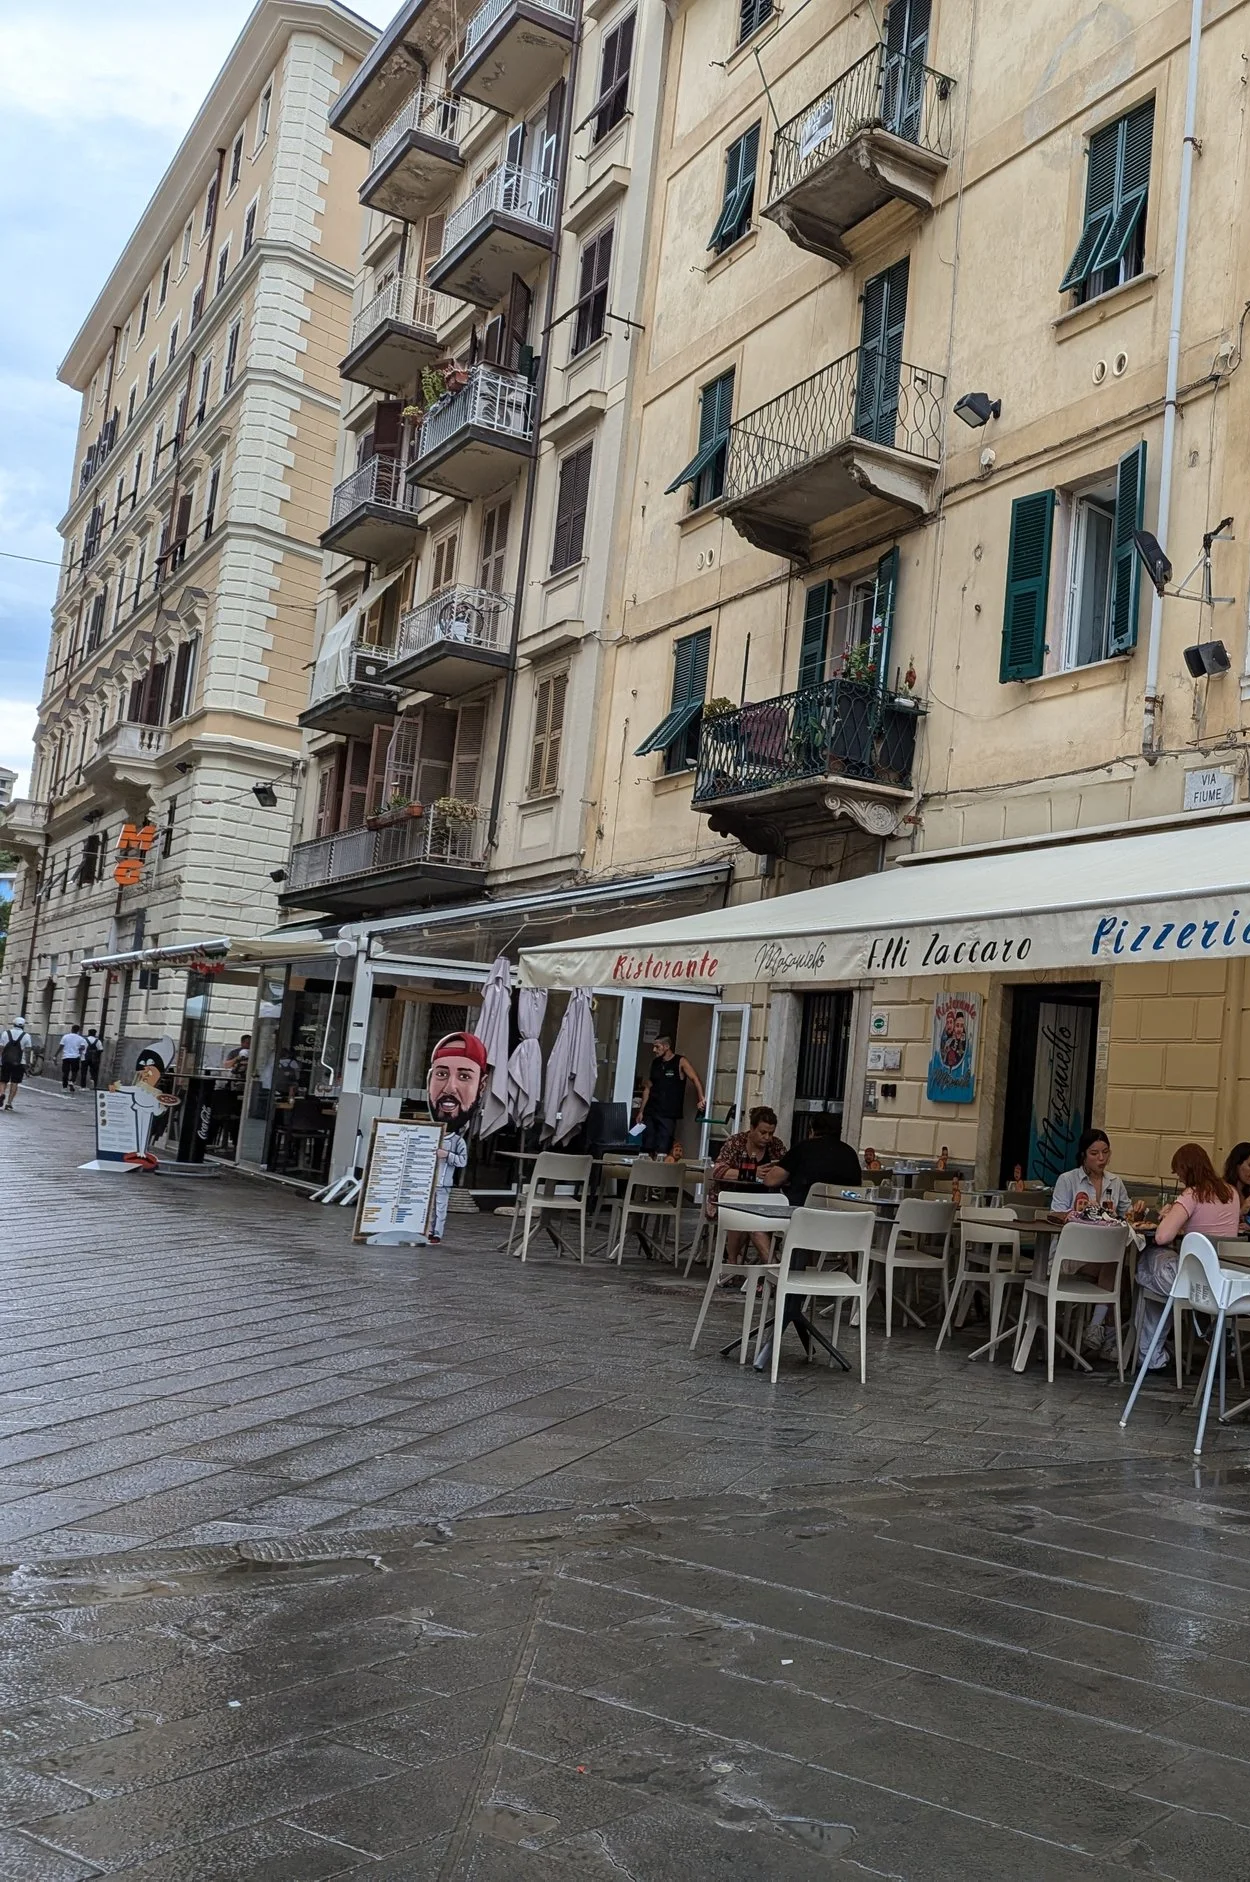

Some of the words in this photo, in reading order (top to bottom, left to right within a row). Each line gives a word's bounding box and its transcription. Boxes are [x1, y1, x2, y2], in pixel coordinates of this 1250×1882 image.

[1202, 773, 1217, 786] VIA
[1193, 788, 1222, 804] FIUME
[612, 950, 719, 980] Ristorante
[921, 932, 1032, 967] Zaccaro
[935, 996, 977, 1021] Ristorante
